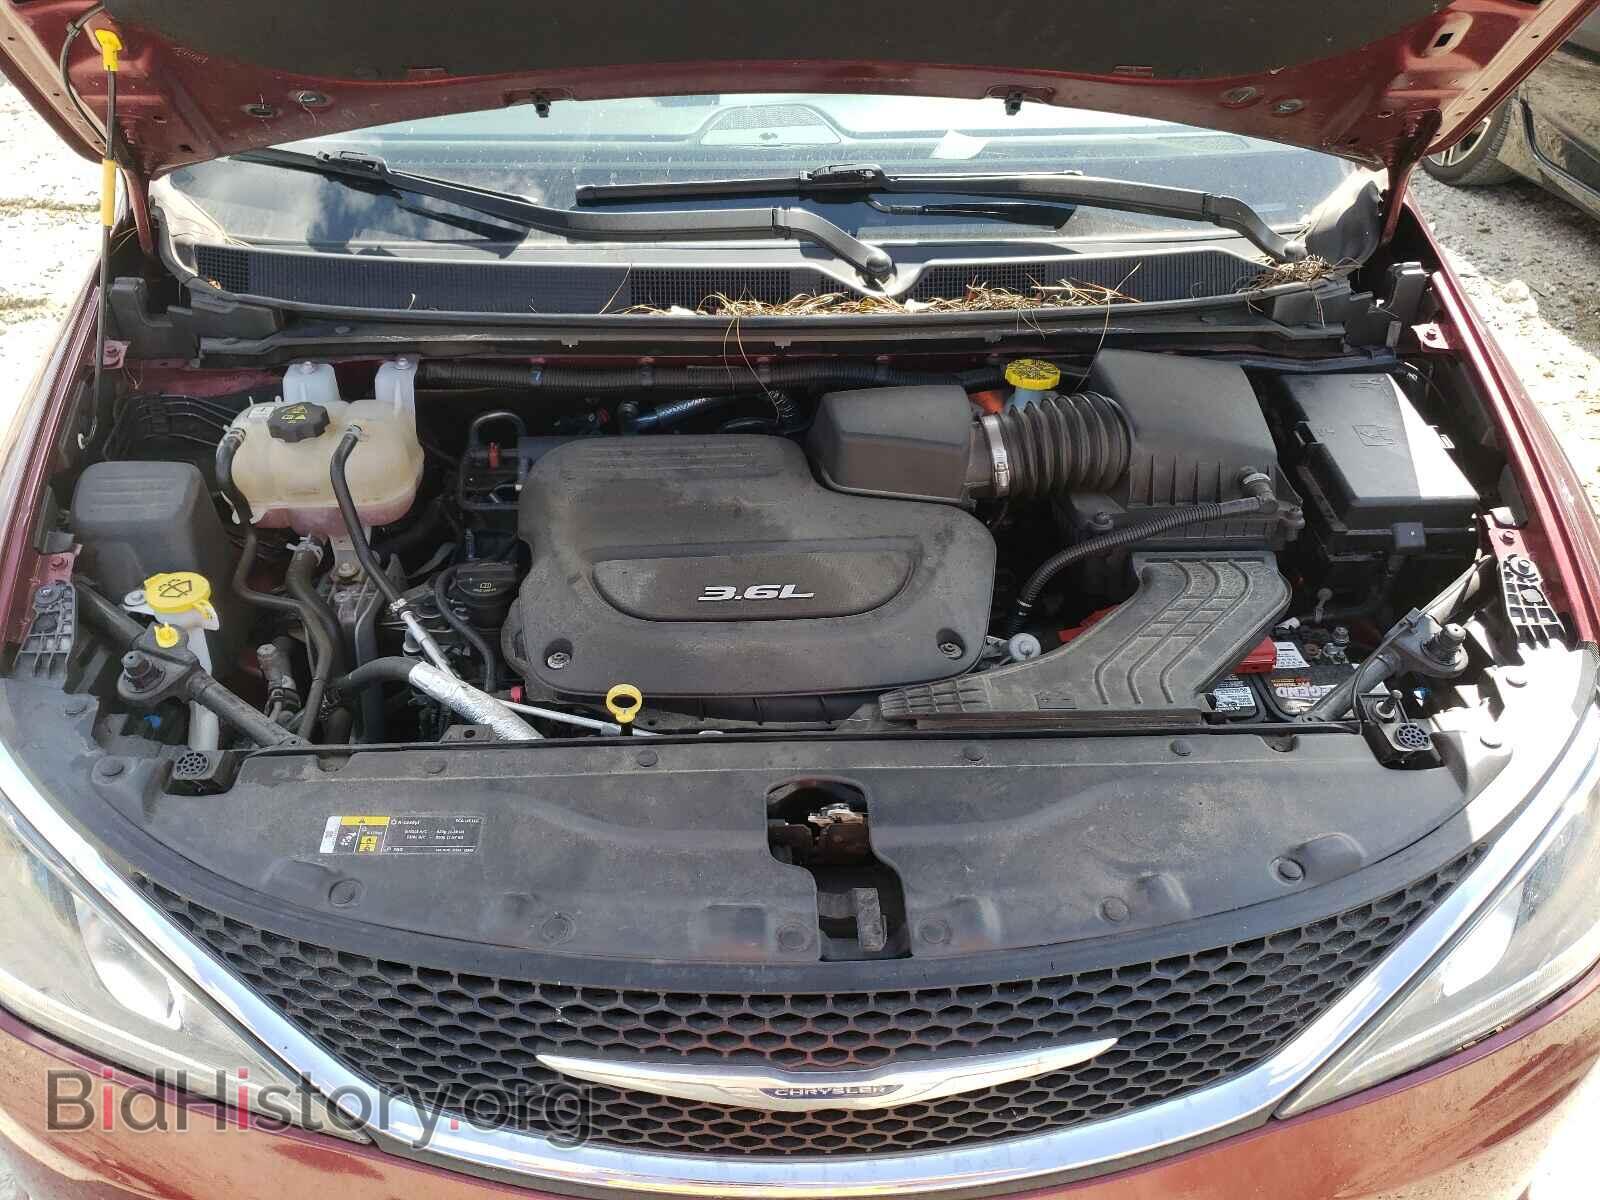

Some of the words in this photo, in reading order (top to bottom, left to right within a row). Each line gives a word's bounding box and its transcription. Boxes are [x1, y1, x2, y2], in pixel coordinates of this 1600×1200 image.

[698, 584, 816, 601] 3.6L
[1275, 685, 1331, 698] EGEND
[774, 1086, 886, 1096] CHRYSLER
